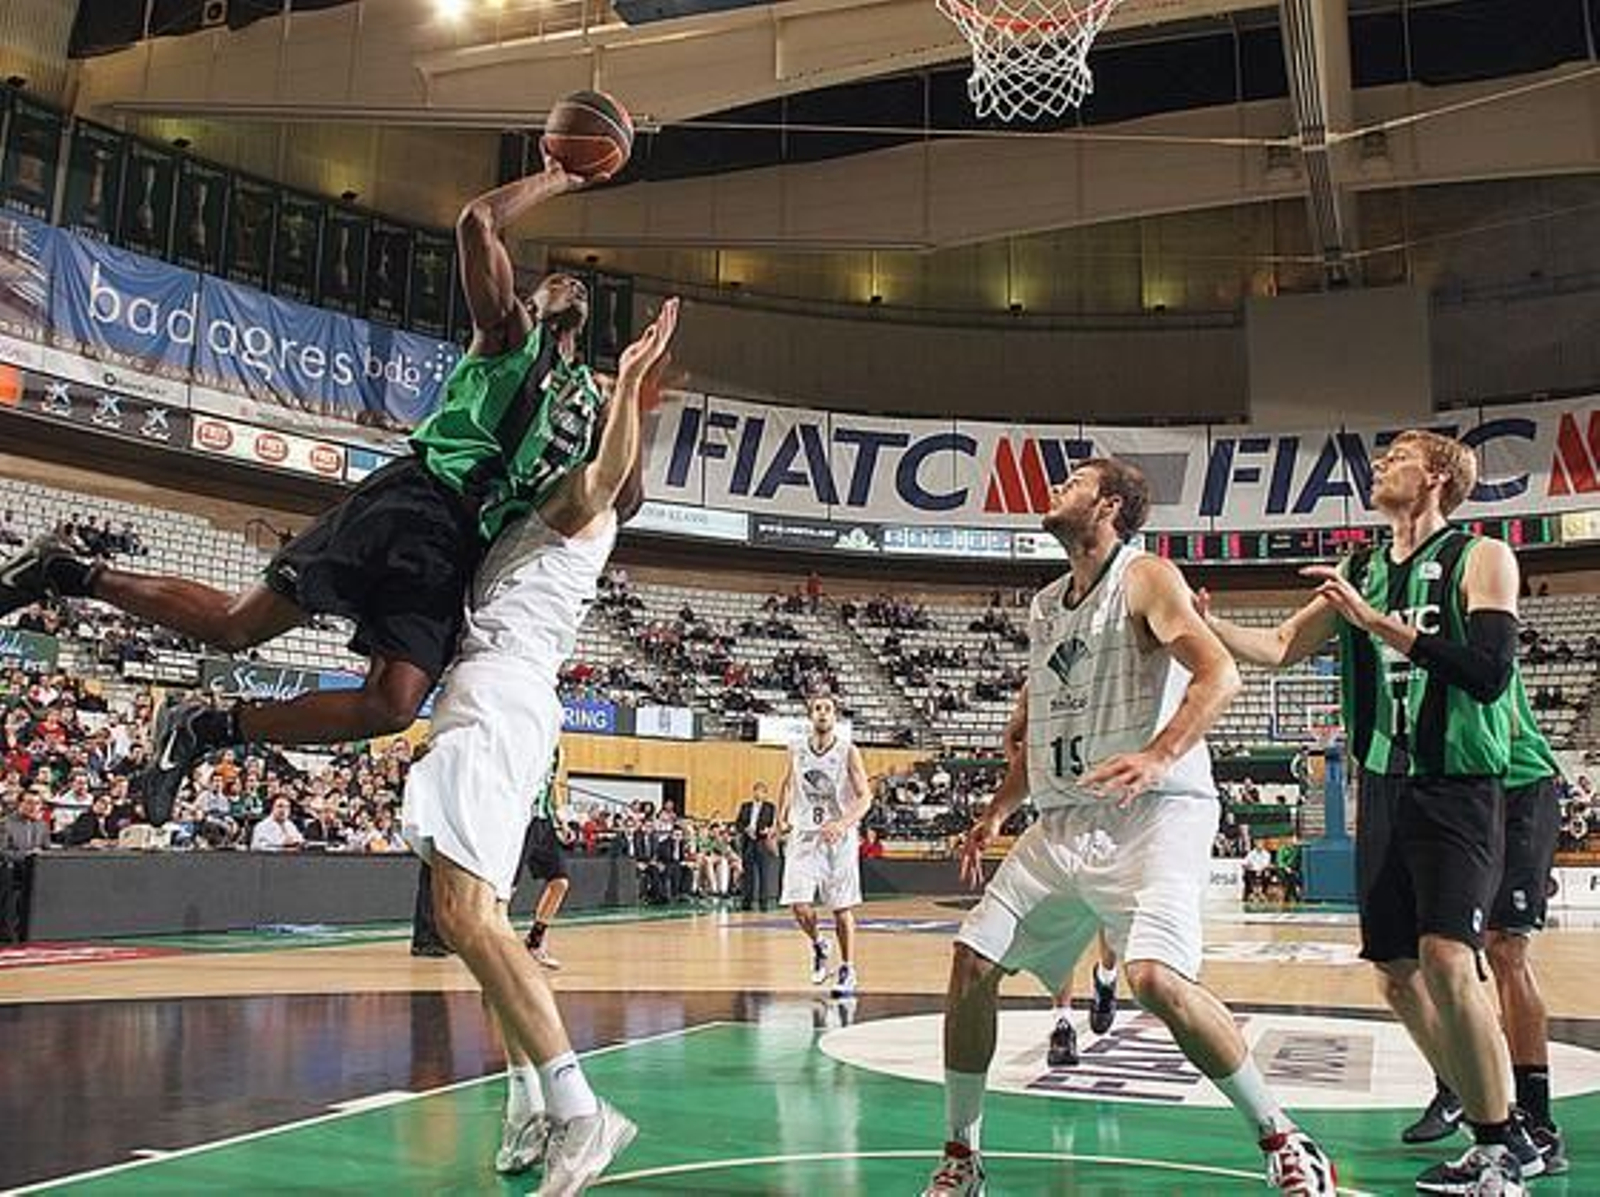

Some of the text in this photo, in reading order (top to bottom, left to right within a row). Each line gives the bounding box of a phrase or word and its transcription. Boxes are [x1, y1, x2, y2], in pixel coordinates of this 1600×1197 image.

[364, 346, 421, 397] bdg
[666, 407, 978, 511] FIATC
[1199, 418, 1537, 516] FIAC
